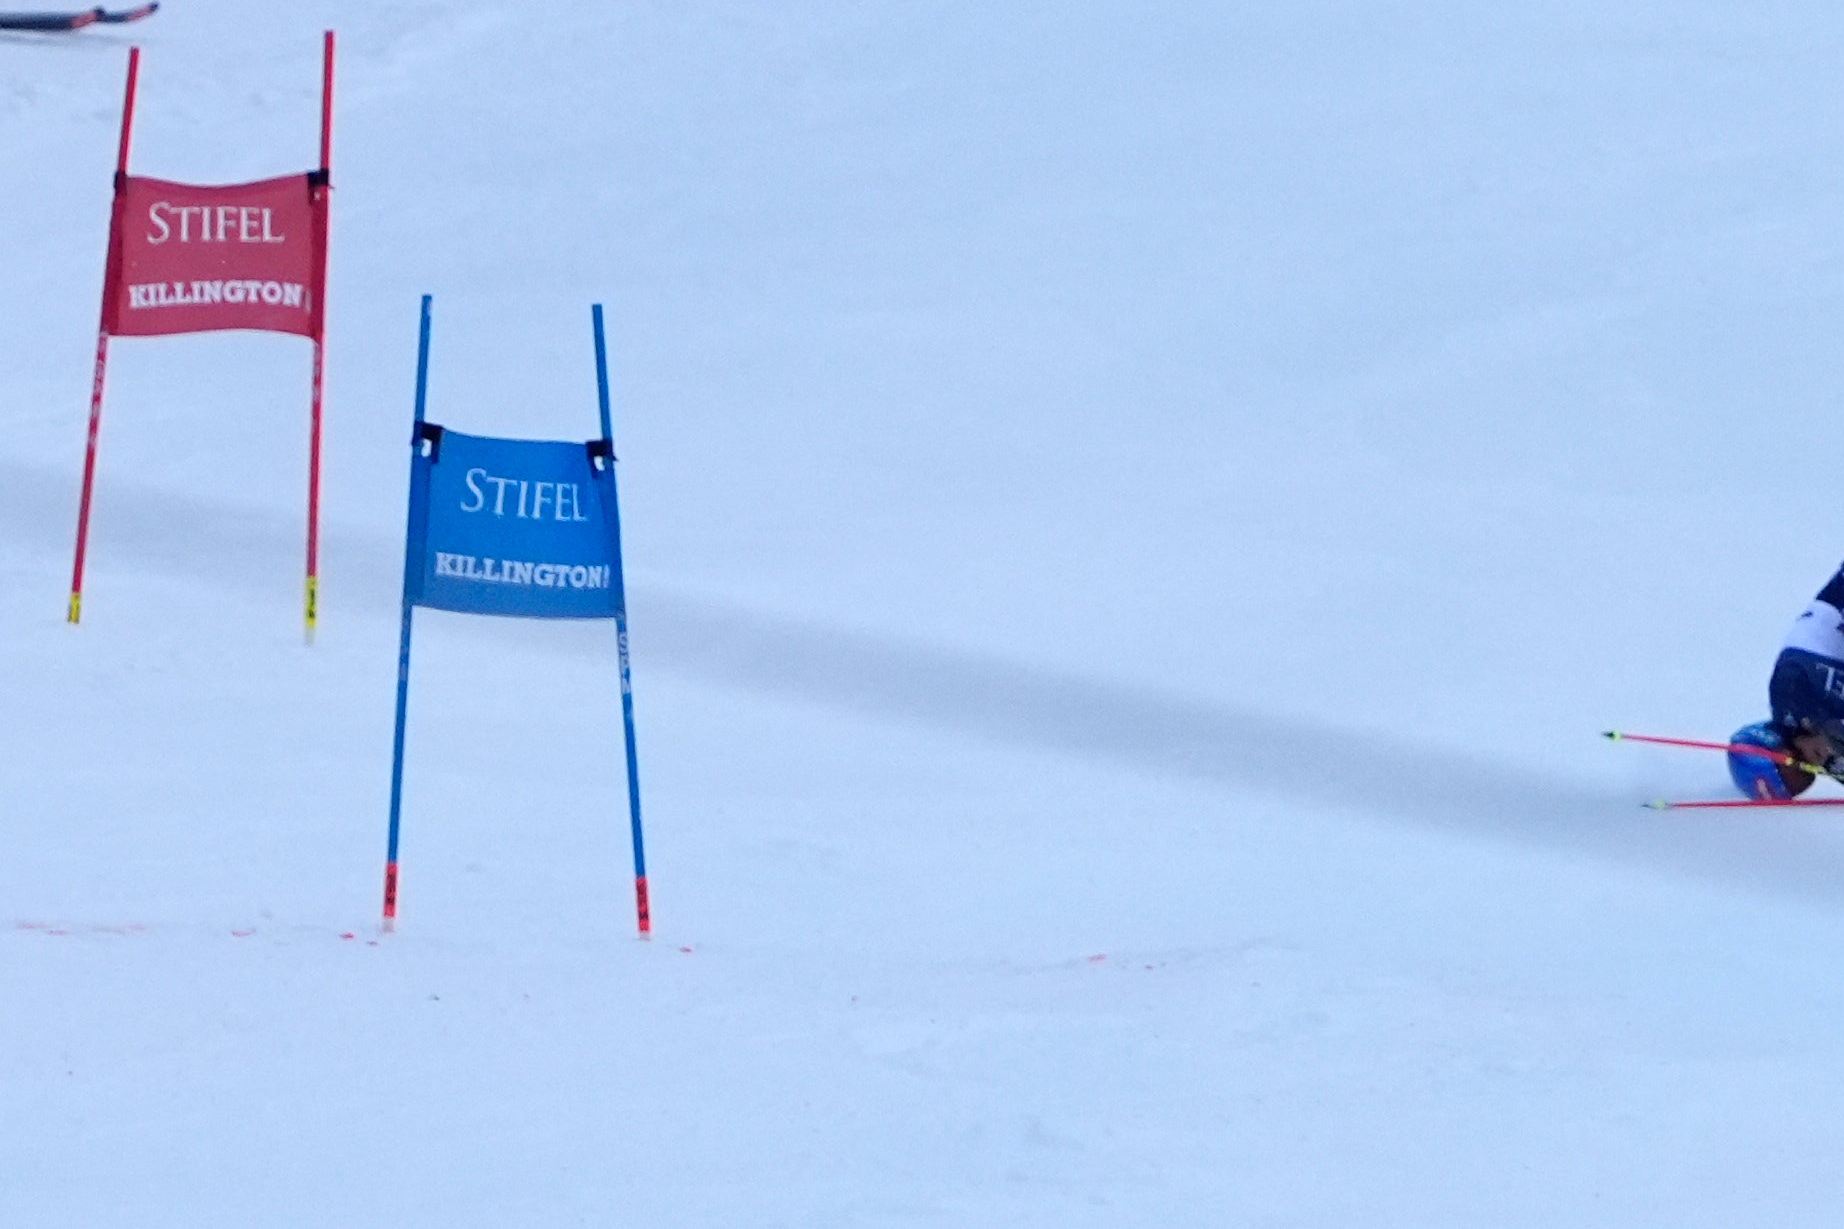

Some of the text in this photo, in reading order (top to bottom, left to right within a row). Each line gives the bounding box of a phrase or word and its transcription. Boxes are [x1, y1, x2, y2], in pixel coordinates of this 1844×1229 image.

[147, 201, 286, 245] STIFEL
[128, 280, 304, 309] KILLINGTON
[460, 467, 588, 522] STIFEL
